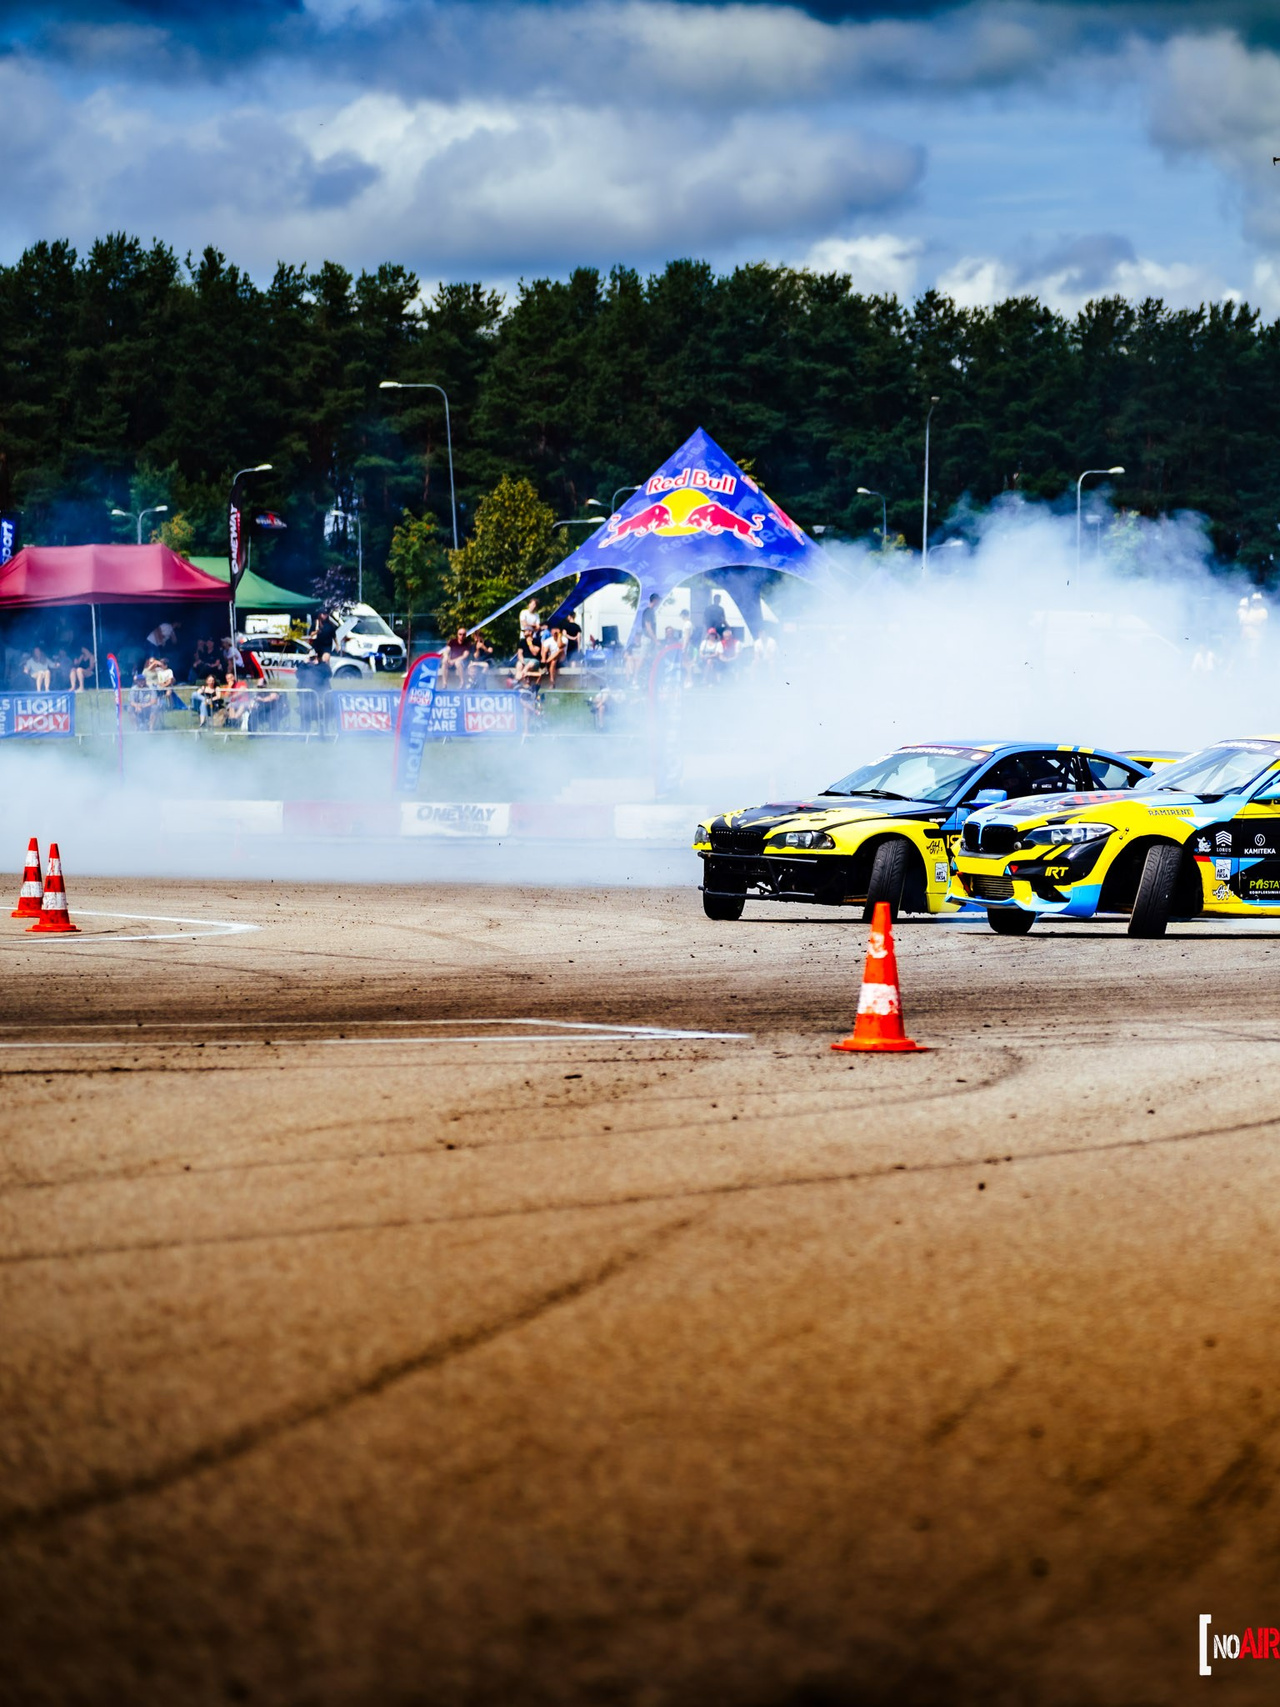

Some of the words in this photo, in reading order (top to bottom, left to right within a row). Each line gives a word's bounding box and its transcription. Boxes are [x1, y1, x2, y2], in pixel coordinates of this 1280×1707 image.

[646, 468, 691, 495] Red
[690, 468, 737, 495] Bull
[2, 521, 13, 565] port
[229, 502, 239, 575] ONEWAY
[17, 697, 67, 715] LIQUI
[341, 696, 387, 713] LIQUI
[434, 695, 461, 707] OILS
[466, 696, 513, 712] LIQUI
[17, 714, 68, 731] MOLY
[343, 713, 391, 729] MOLY
[467, 713, 515, 730] MOLY
[1045, 866, 1069, 879] IRT
